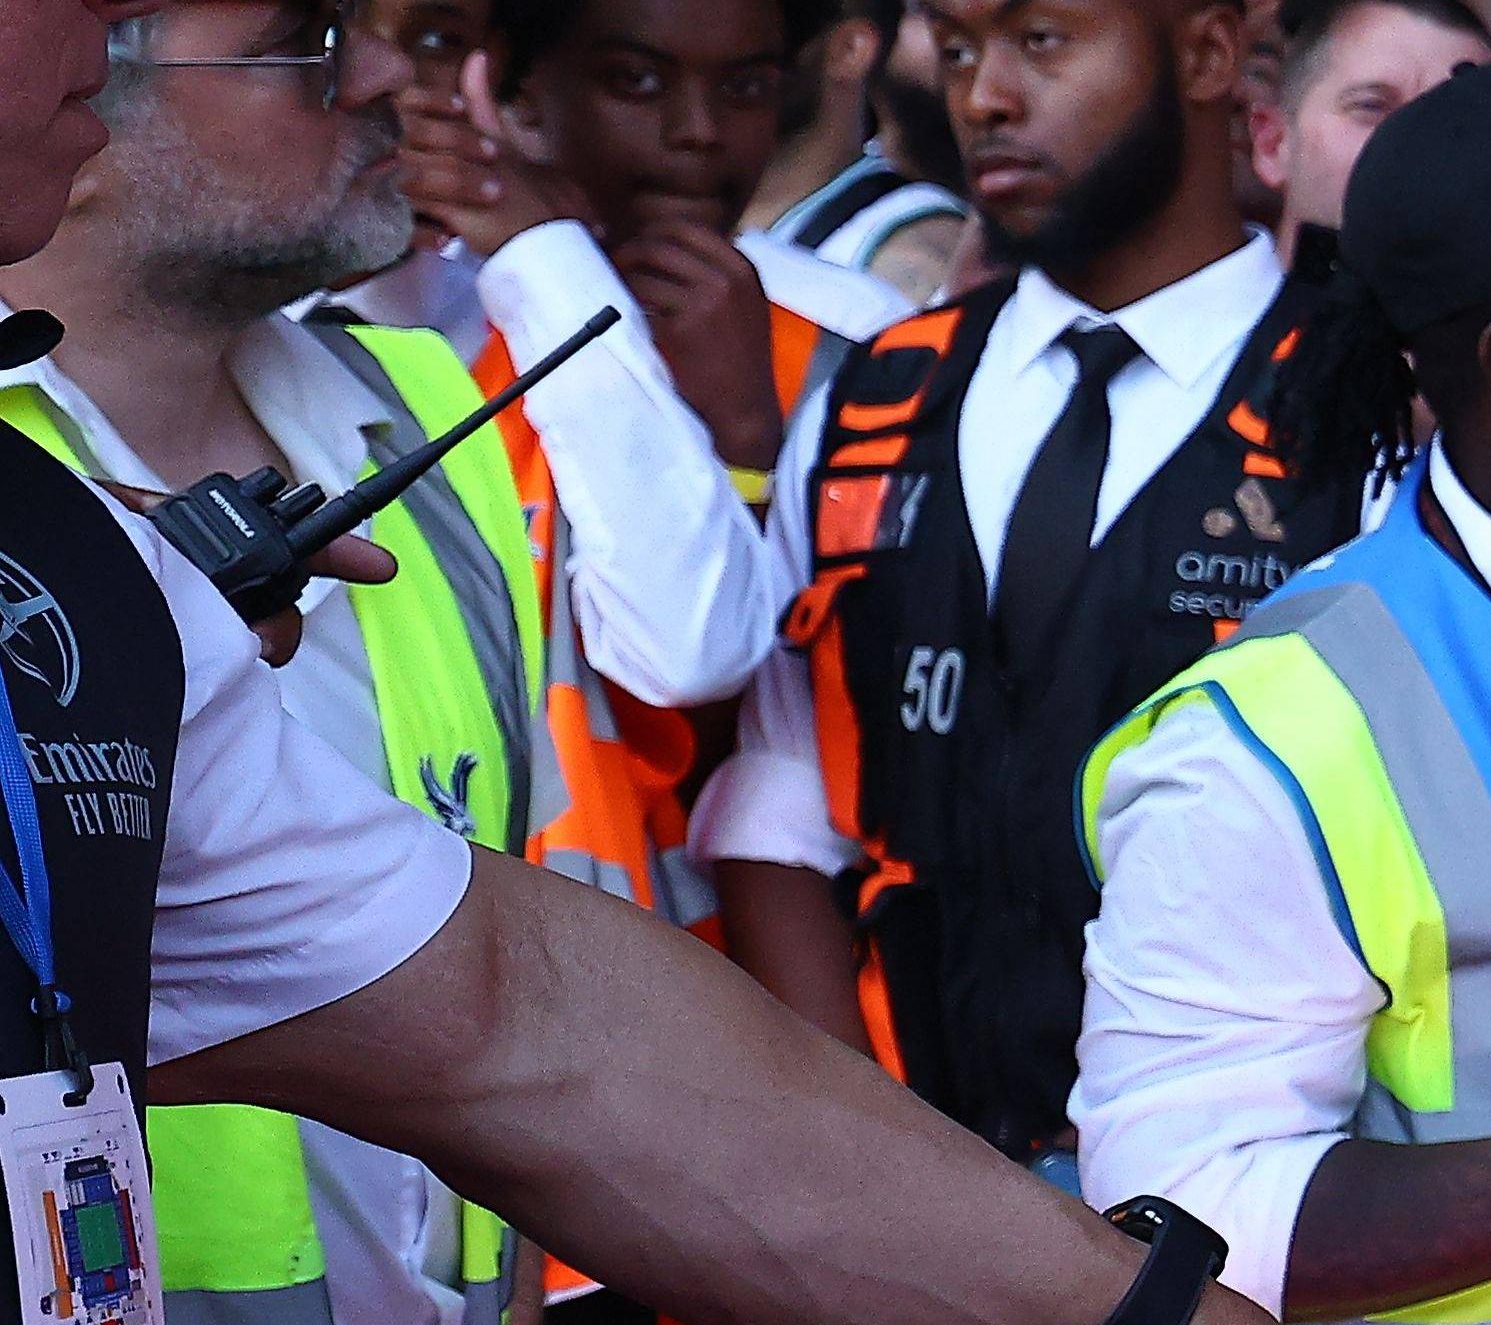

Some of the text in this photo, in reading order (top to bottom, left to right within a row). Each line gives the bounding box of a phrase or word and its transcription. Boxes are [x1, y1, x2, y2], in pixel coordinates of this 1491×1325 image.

[1168, 590, 1262, 619] secur
[899, 645, 963, 735] 50
[16, 732, 156, 790] Emirates
[64, 792, 105, 836] FLY
